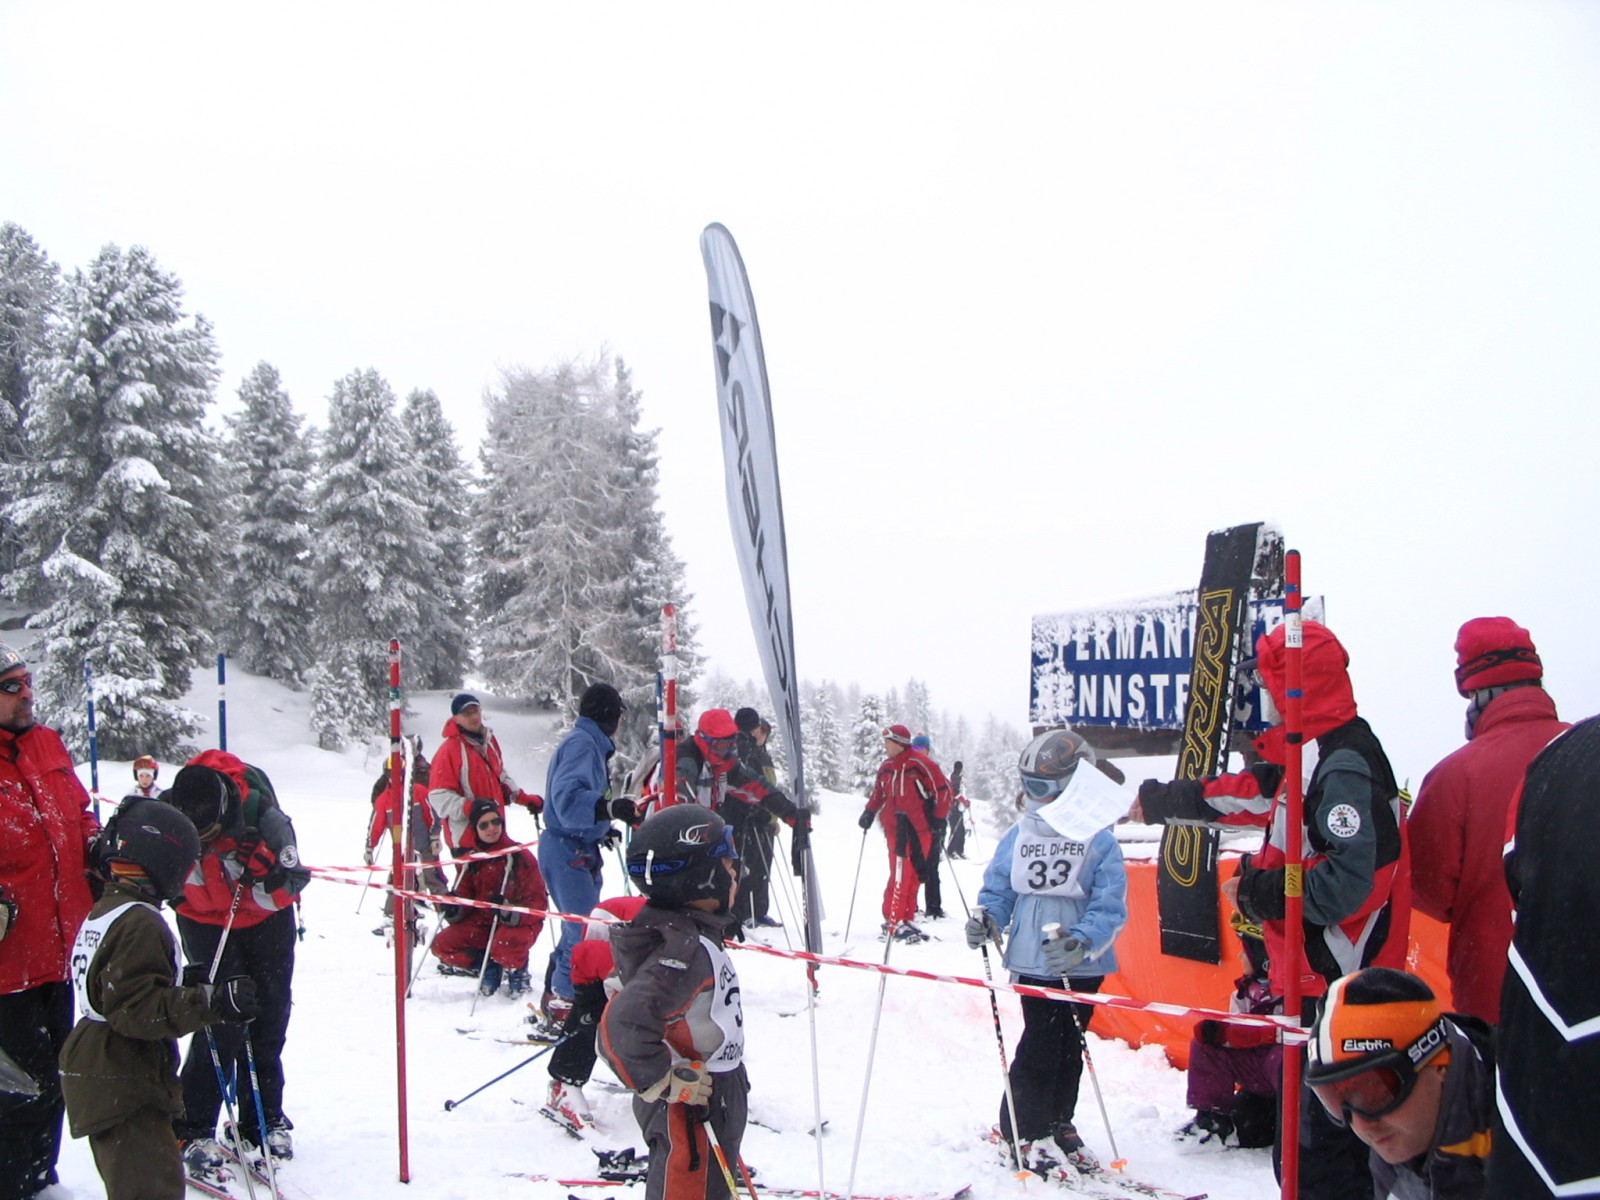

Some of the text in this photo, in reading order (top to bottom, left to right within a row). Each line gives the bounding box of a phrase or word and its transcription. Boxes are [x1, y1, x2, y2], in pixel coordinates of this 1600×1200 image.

[1163, 588, 1234, 888] CRRERA
[1020, 842, 1085, 858] OPEL DI-FER
[1027, 859, 1072, 890] 33
